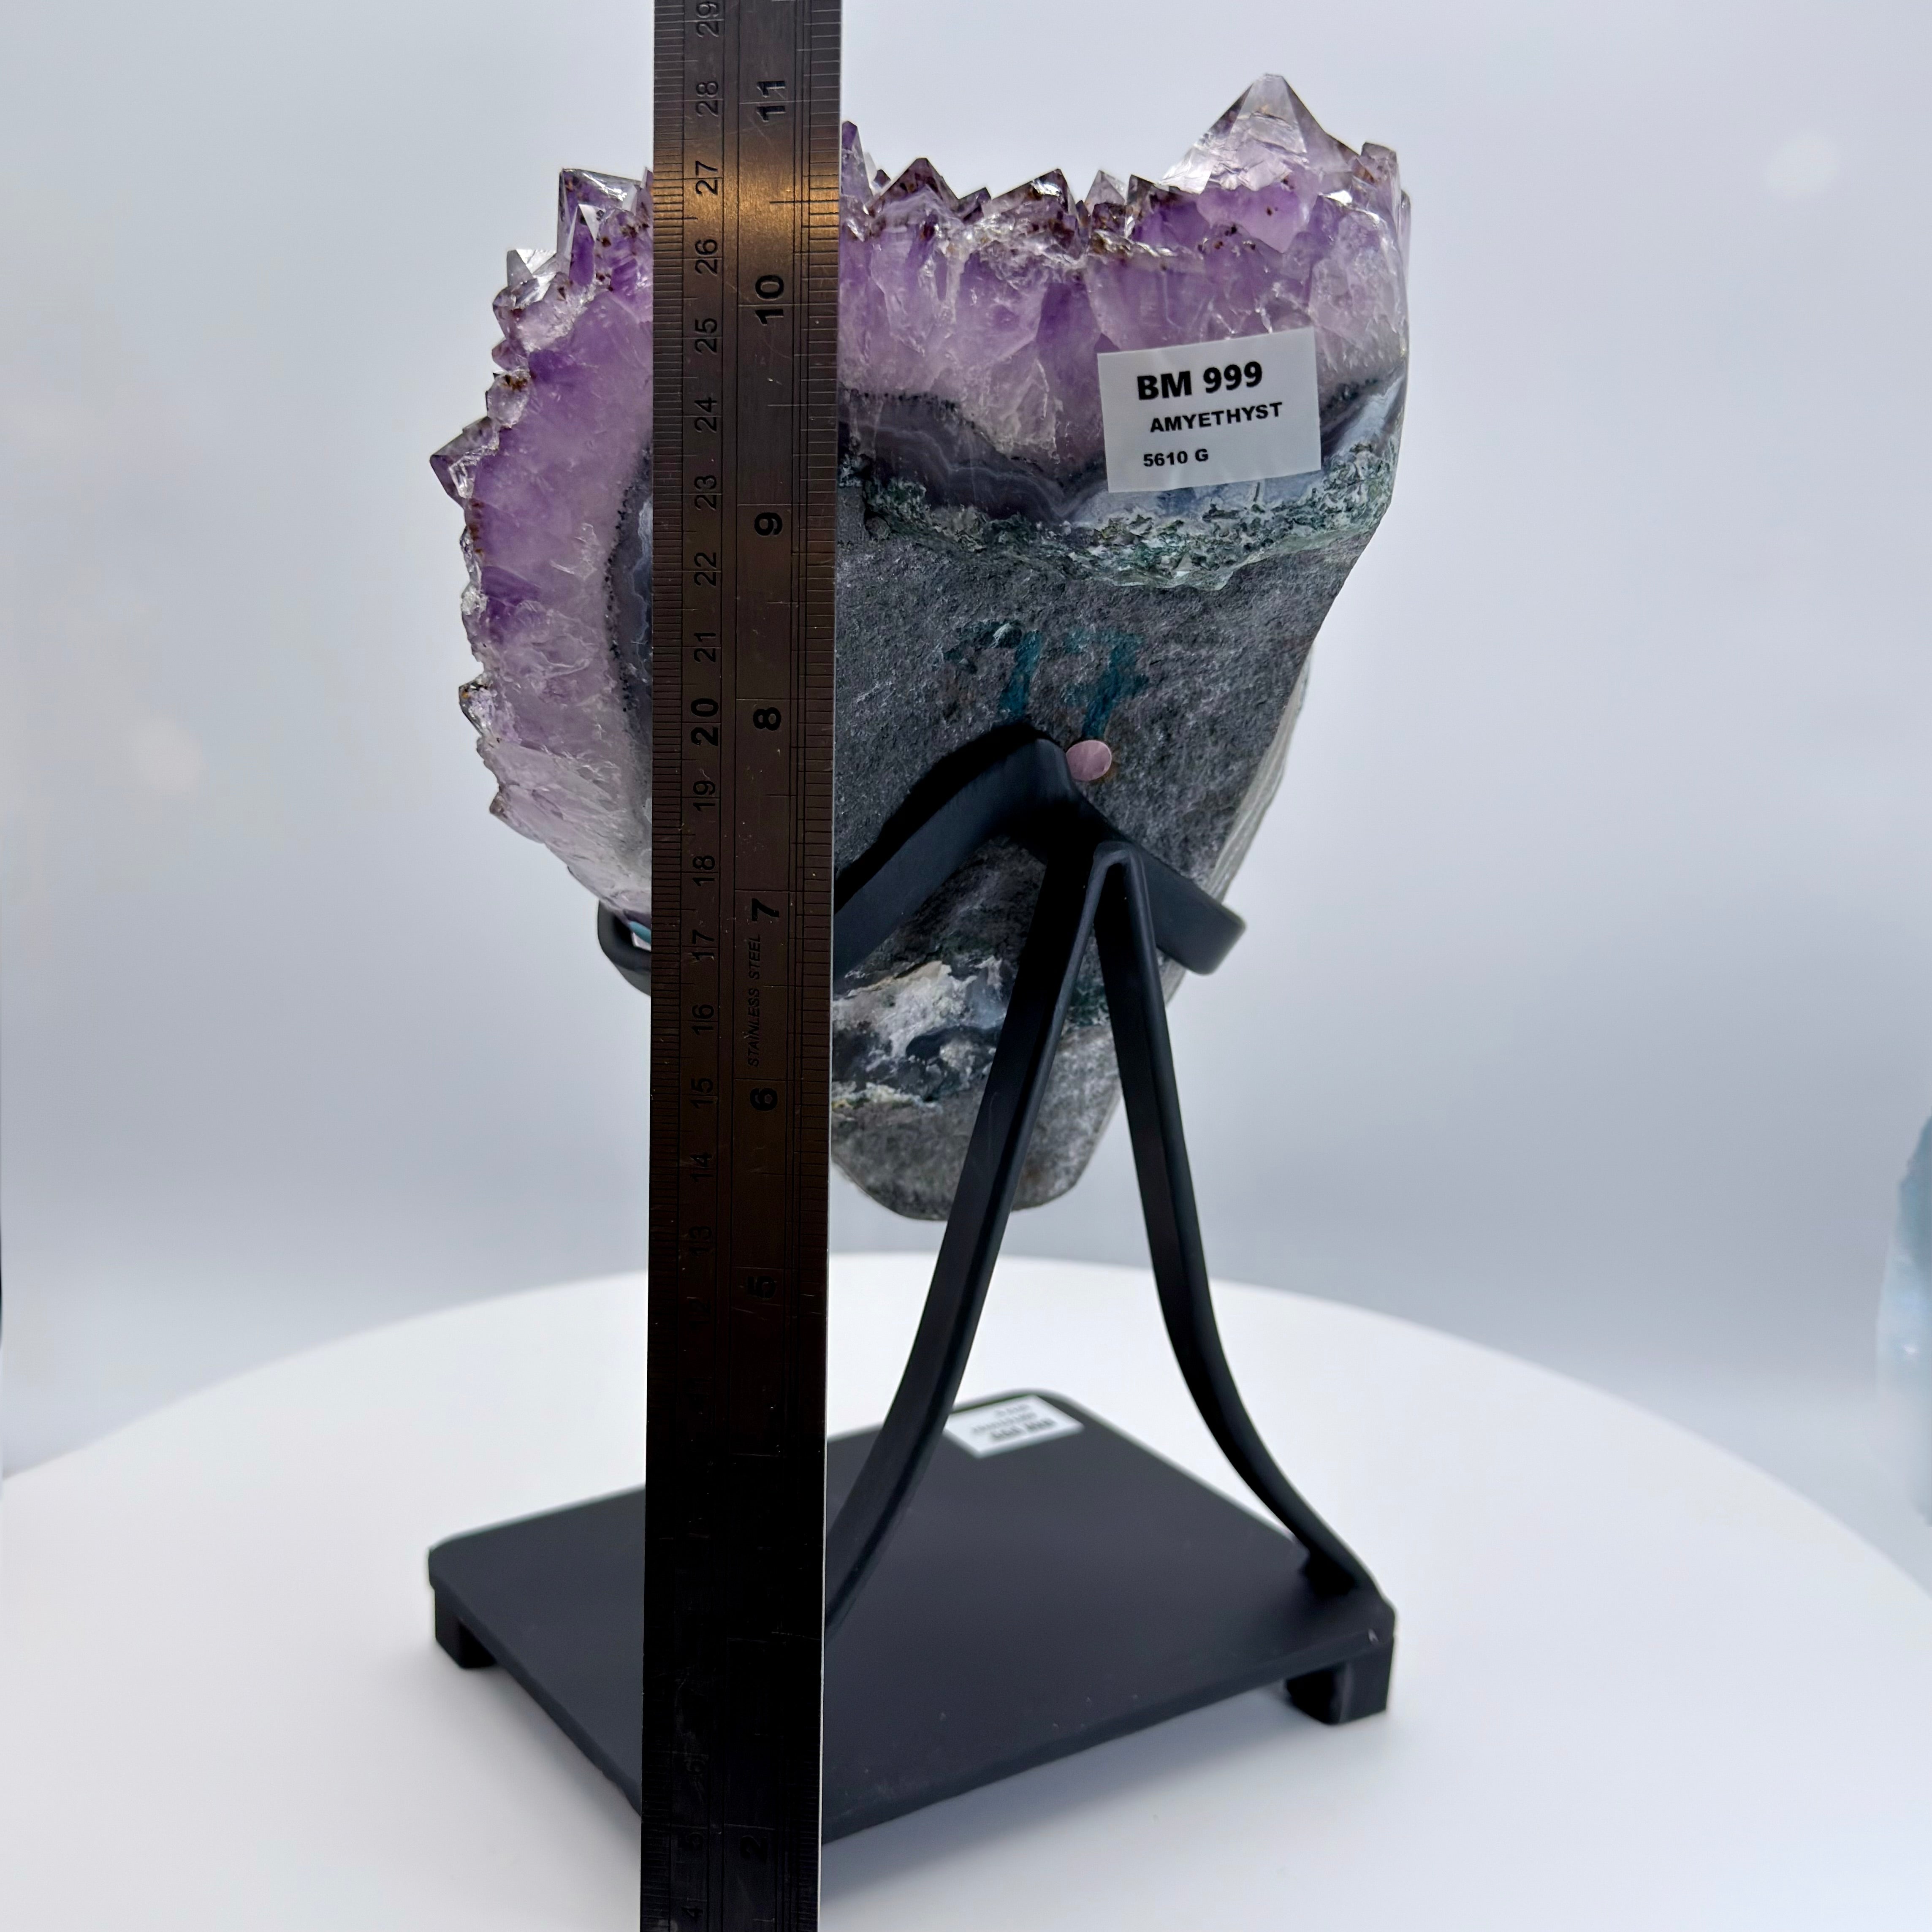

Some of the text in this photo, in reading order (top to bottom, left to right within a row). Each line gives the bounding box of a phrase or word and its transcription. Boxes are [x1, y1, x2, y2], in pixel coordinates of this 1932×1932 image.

[696, 1, 719, 37] 29
[696, 81, 718, 117] 28
[756, 81, 786, 122] 11
[695, 160, 718, 195] 27
[695, 239, 718, 276] 26
[755, 275, 784, 326] 10
[695, 318, 718, 355] 25
[1137, 361, 1262, 400] BM 999
[695, 397, 717, 433] 24
[1150, 402, 1282, 433] AMYETHYST
[1143, 449, 1209, 467] 5610 G
[694, 475, 717, 510] 23
[754, 512, 782, 536] 9
[694, 552, 716, 586] 22
[694, 633, 716, 662] 21
[691, 698, 719, 746] 20
[753, 707, 781, 730] 8
[693, 780, 716, 811] 19
[692, 855, 715, 886] 18
[752, 898, 779, 922] 7
[692, 929, 714, 962] 17
[748, 933, 760, 1067] STAINLESS STEEL
[692, 1004, 714, 1035] 16
[691, 1078, 714, 1109] 15
[750, 1088, 778, 1111] 6
[690, 1152, 714, 1182] 14
[689, 1226, 712, 1256] 13
[747, 1275, 776, 1300] 5
